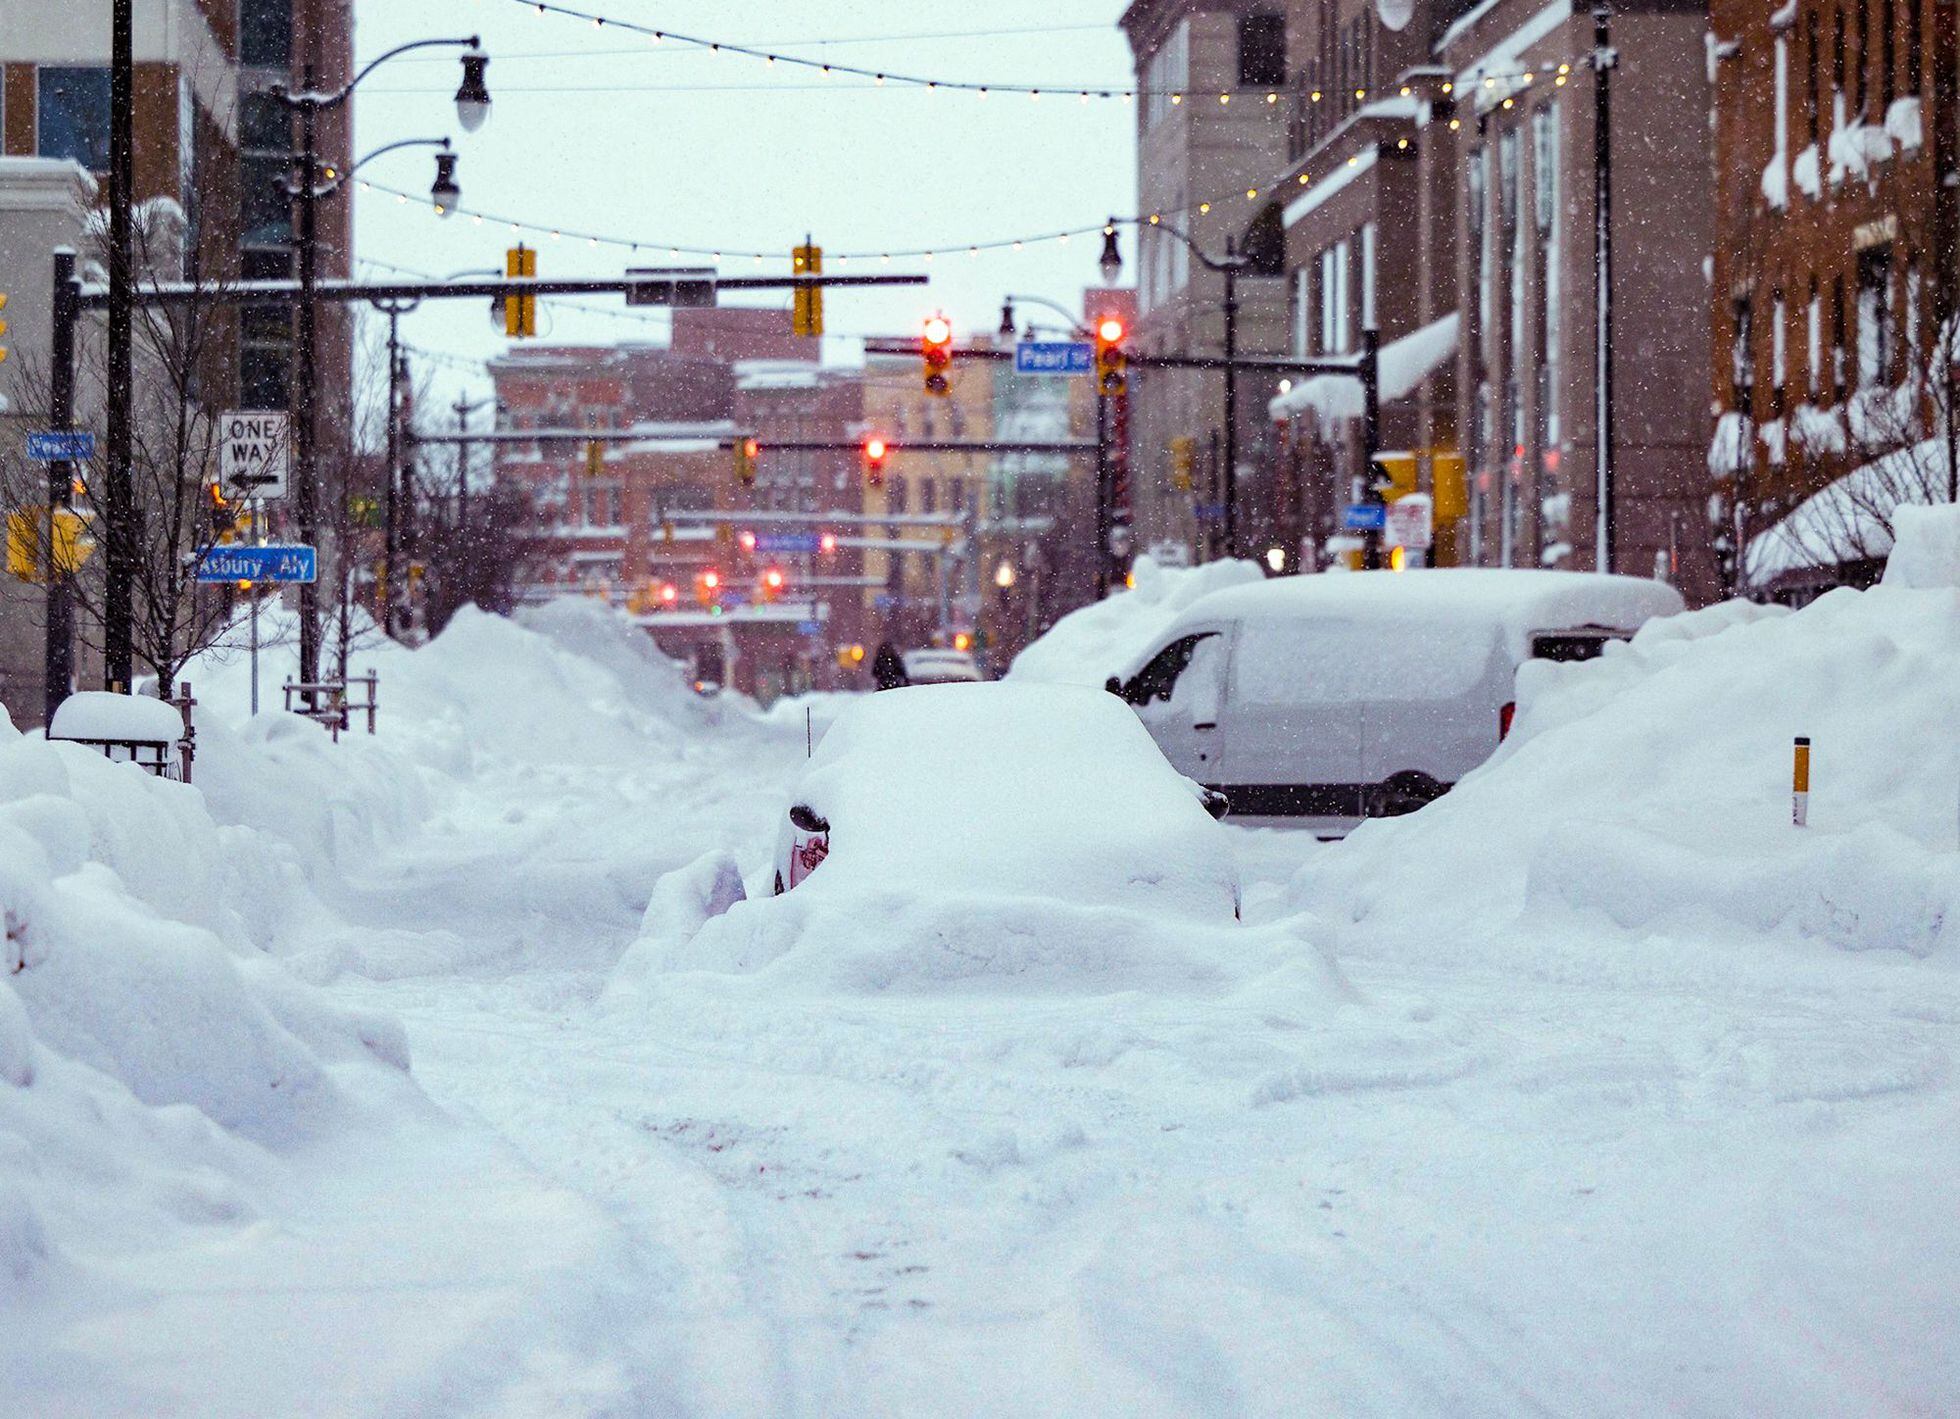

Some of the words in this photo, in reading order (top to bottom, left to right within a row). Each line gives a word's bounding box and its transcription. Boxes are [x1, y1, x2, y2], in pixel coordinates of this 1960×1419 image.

[1021, 348, 1069, 368] Pearl
[231, 420, 276, 439] ONE
[232, 443, 278, 462] WAY
[199, 555, 262, 577] Asbury
[281, 554, 310, 579] Aly
